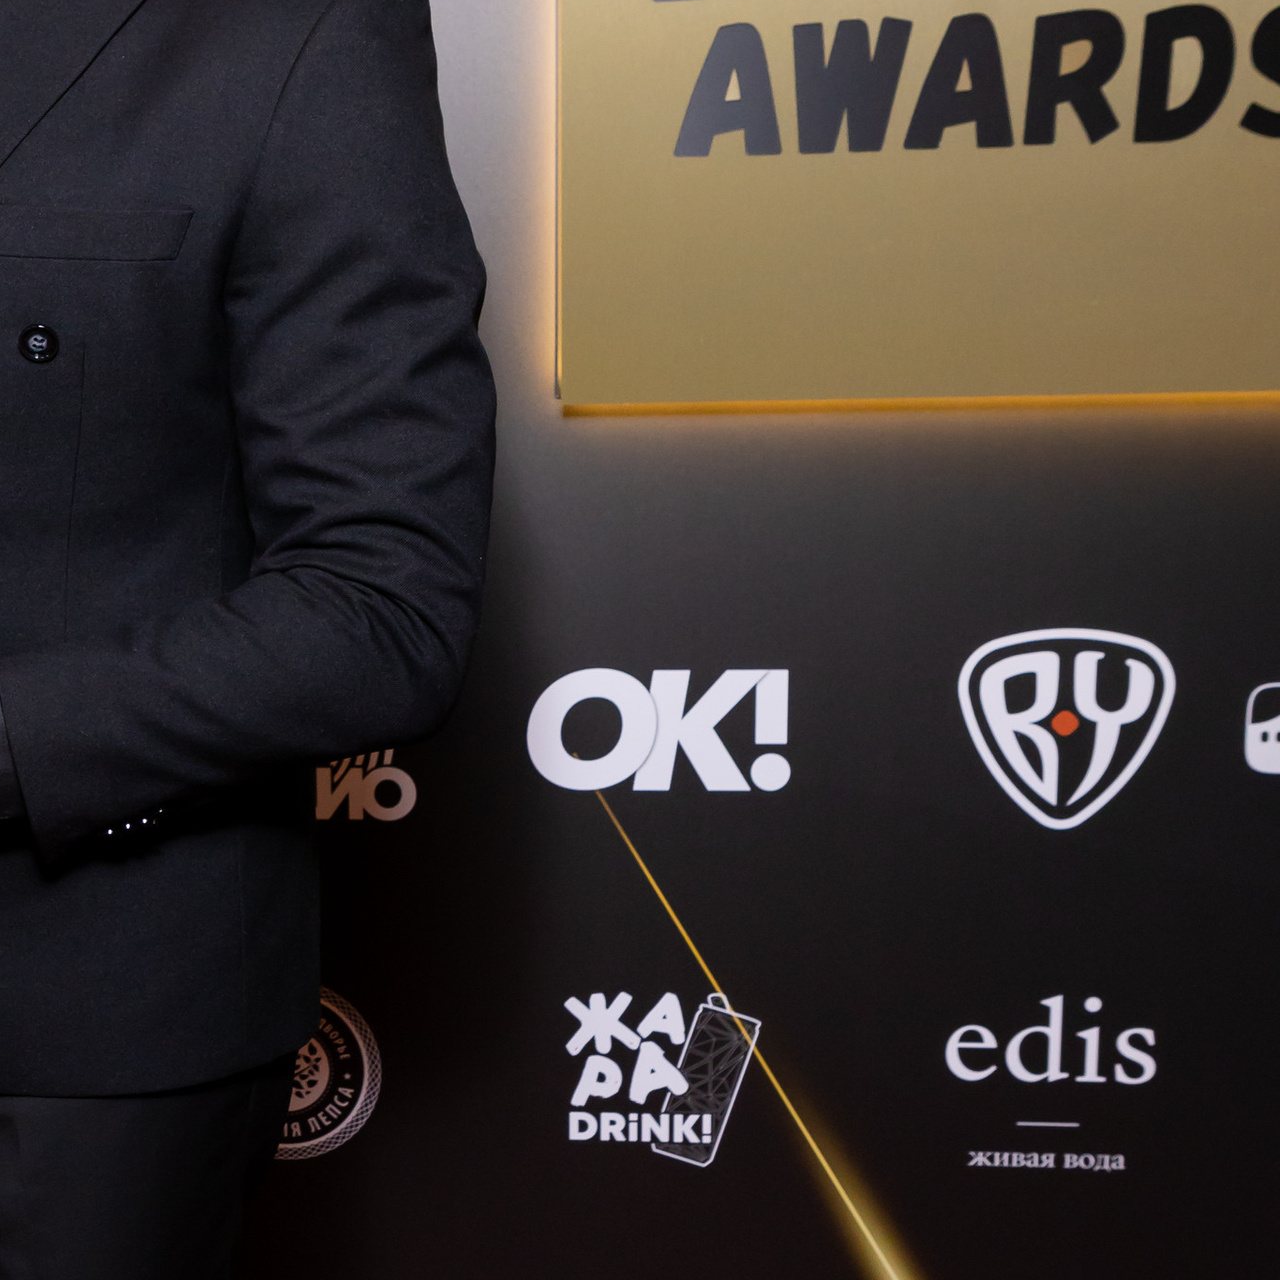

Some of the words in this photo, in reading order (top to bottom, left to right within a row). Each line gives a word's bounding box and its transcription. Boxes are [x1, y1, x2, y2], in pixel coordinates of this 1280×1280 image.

[527, 668, 791, 792] OK!
[945, 995, 1157, 1085] edis
[307, 1086, 355, 1133] ЛЕПСА
[967, 1150, 1056, 1169] живая
[1063, 1152, 1126, 1173] вода
